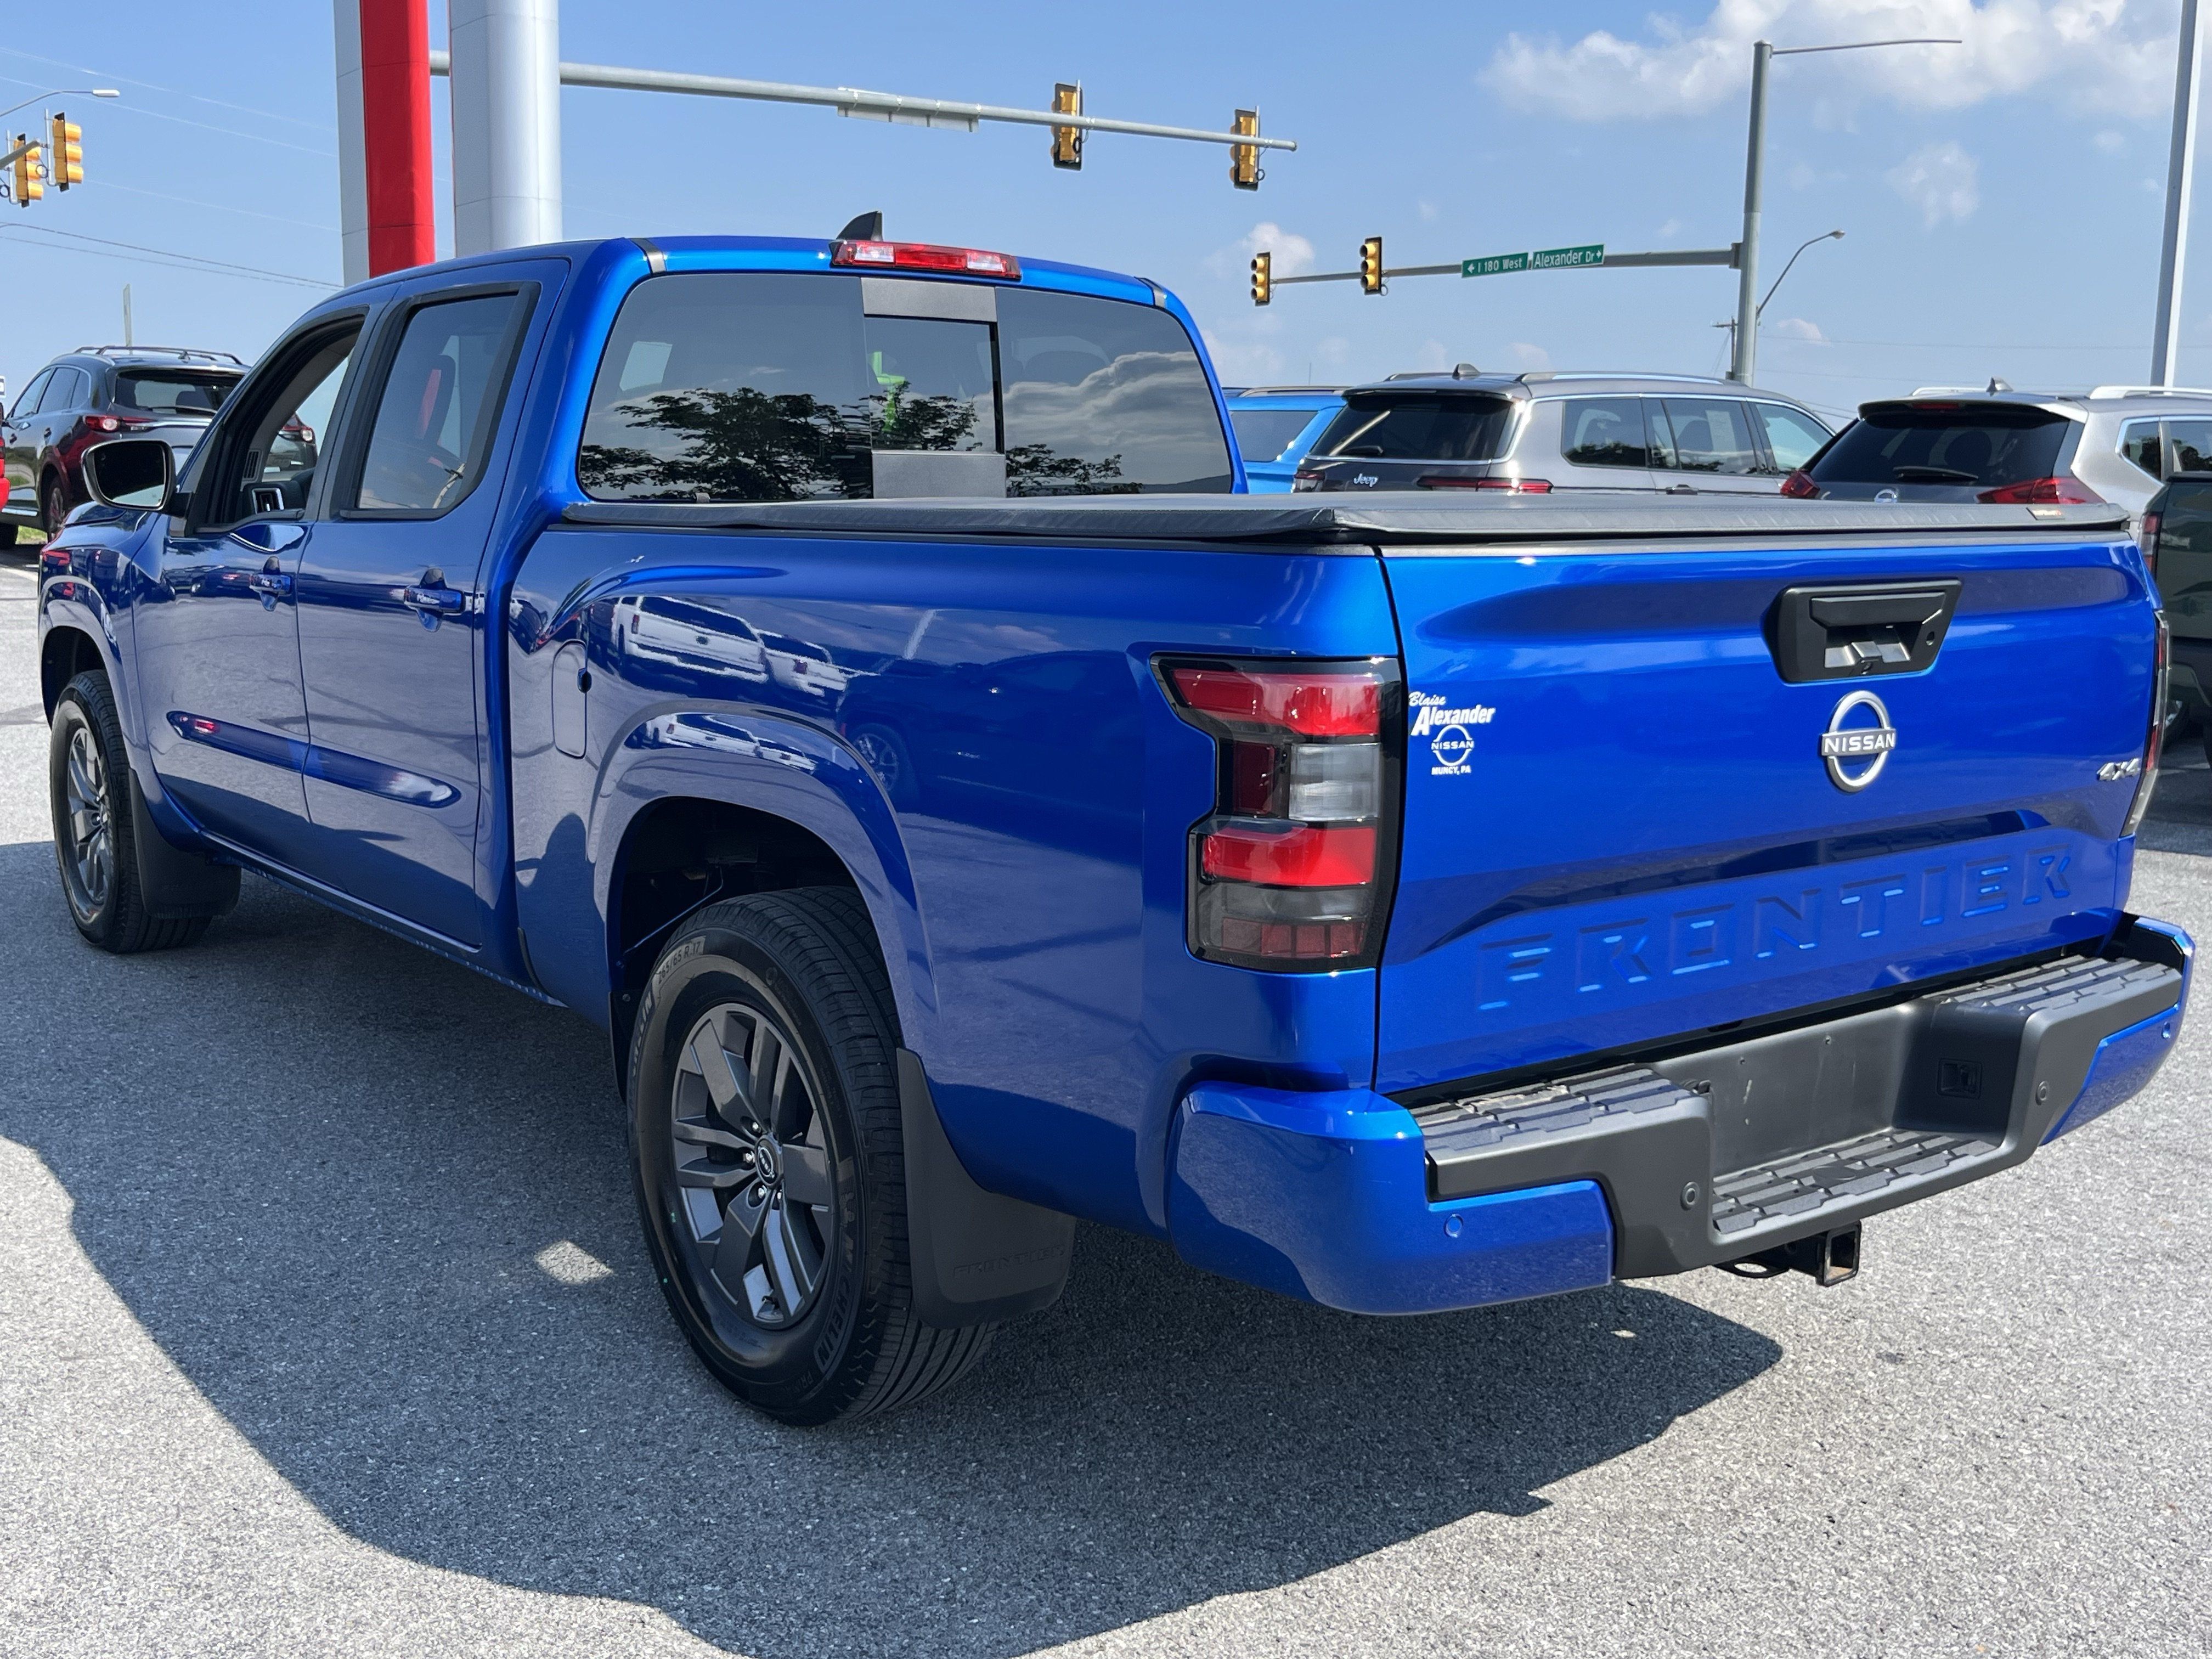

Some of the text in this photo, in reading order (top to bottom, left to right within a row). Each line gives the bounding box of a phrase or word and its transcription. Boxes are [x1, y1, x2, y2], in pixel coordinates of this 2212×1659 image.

[1477, 258, 1522, 273] I 180 West
[1534, 250, 1594, 268] Alexander Dr
[1353, 472, 1379, 487] Jeep
[1408, 691, 1446, 706] Blaise
[1410, 704, 1496, 736] Alexander
[1431, 741, 1475, 750] NISSAN
[1824, 733, 1895, 753] NISSAN
[1431, 765, 1471, 775] MUNCY, PA
[1477, 843, 2069, 1010] FRONTIER
[658, 941, 701, 985] 265/65 R 17
